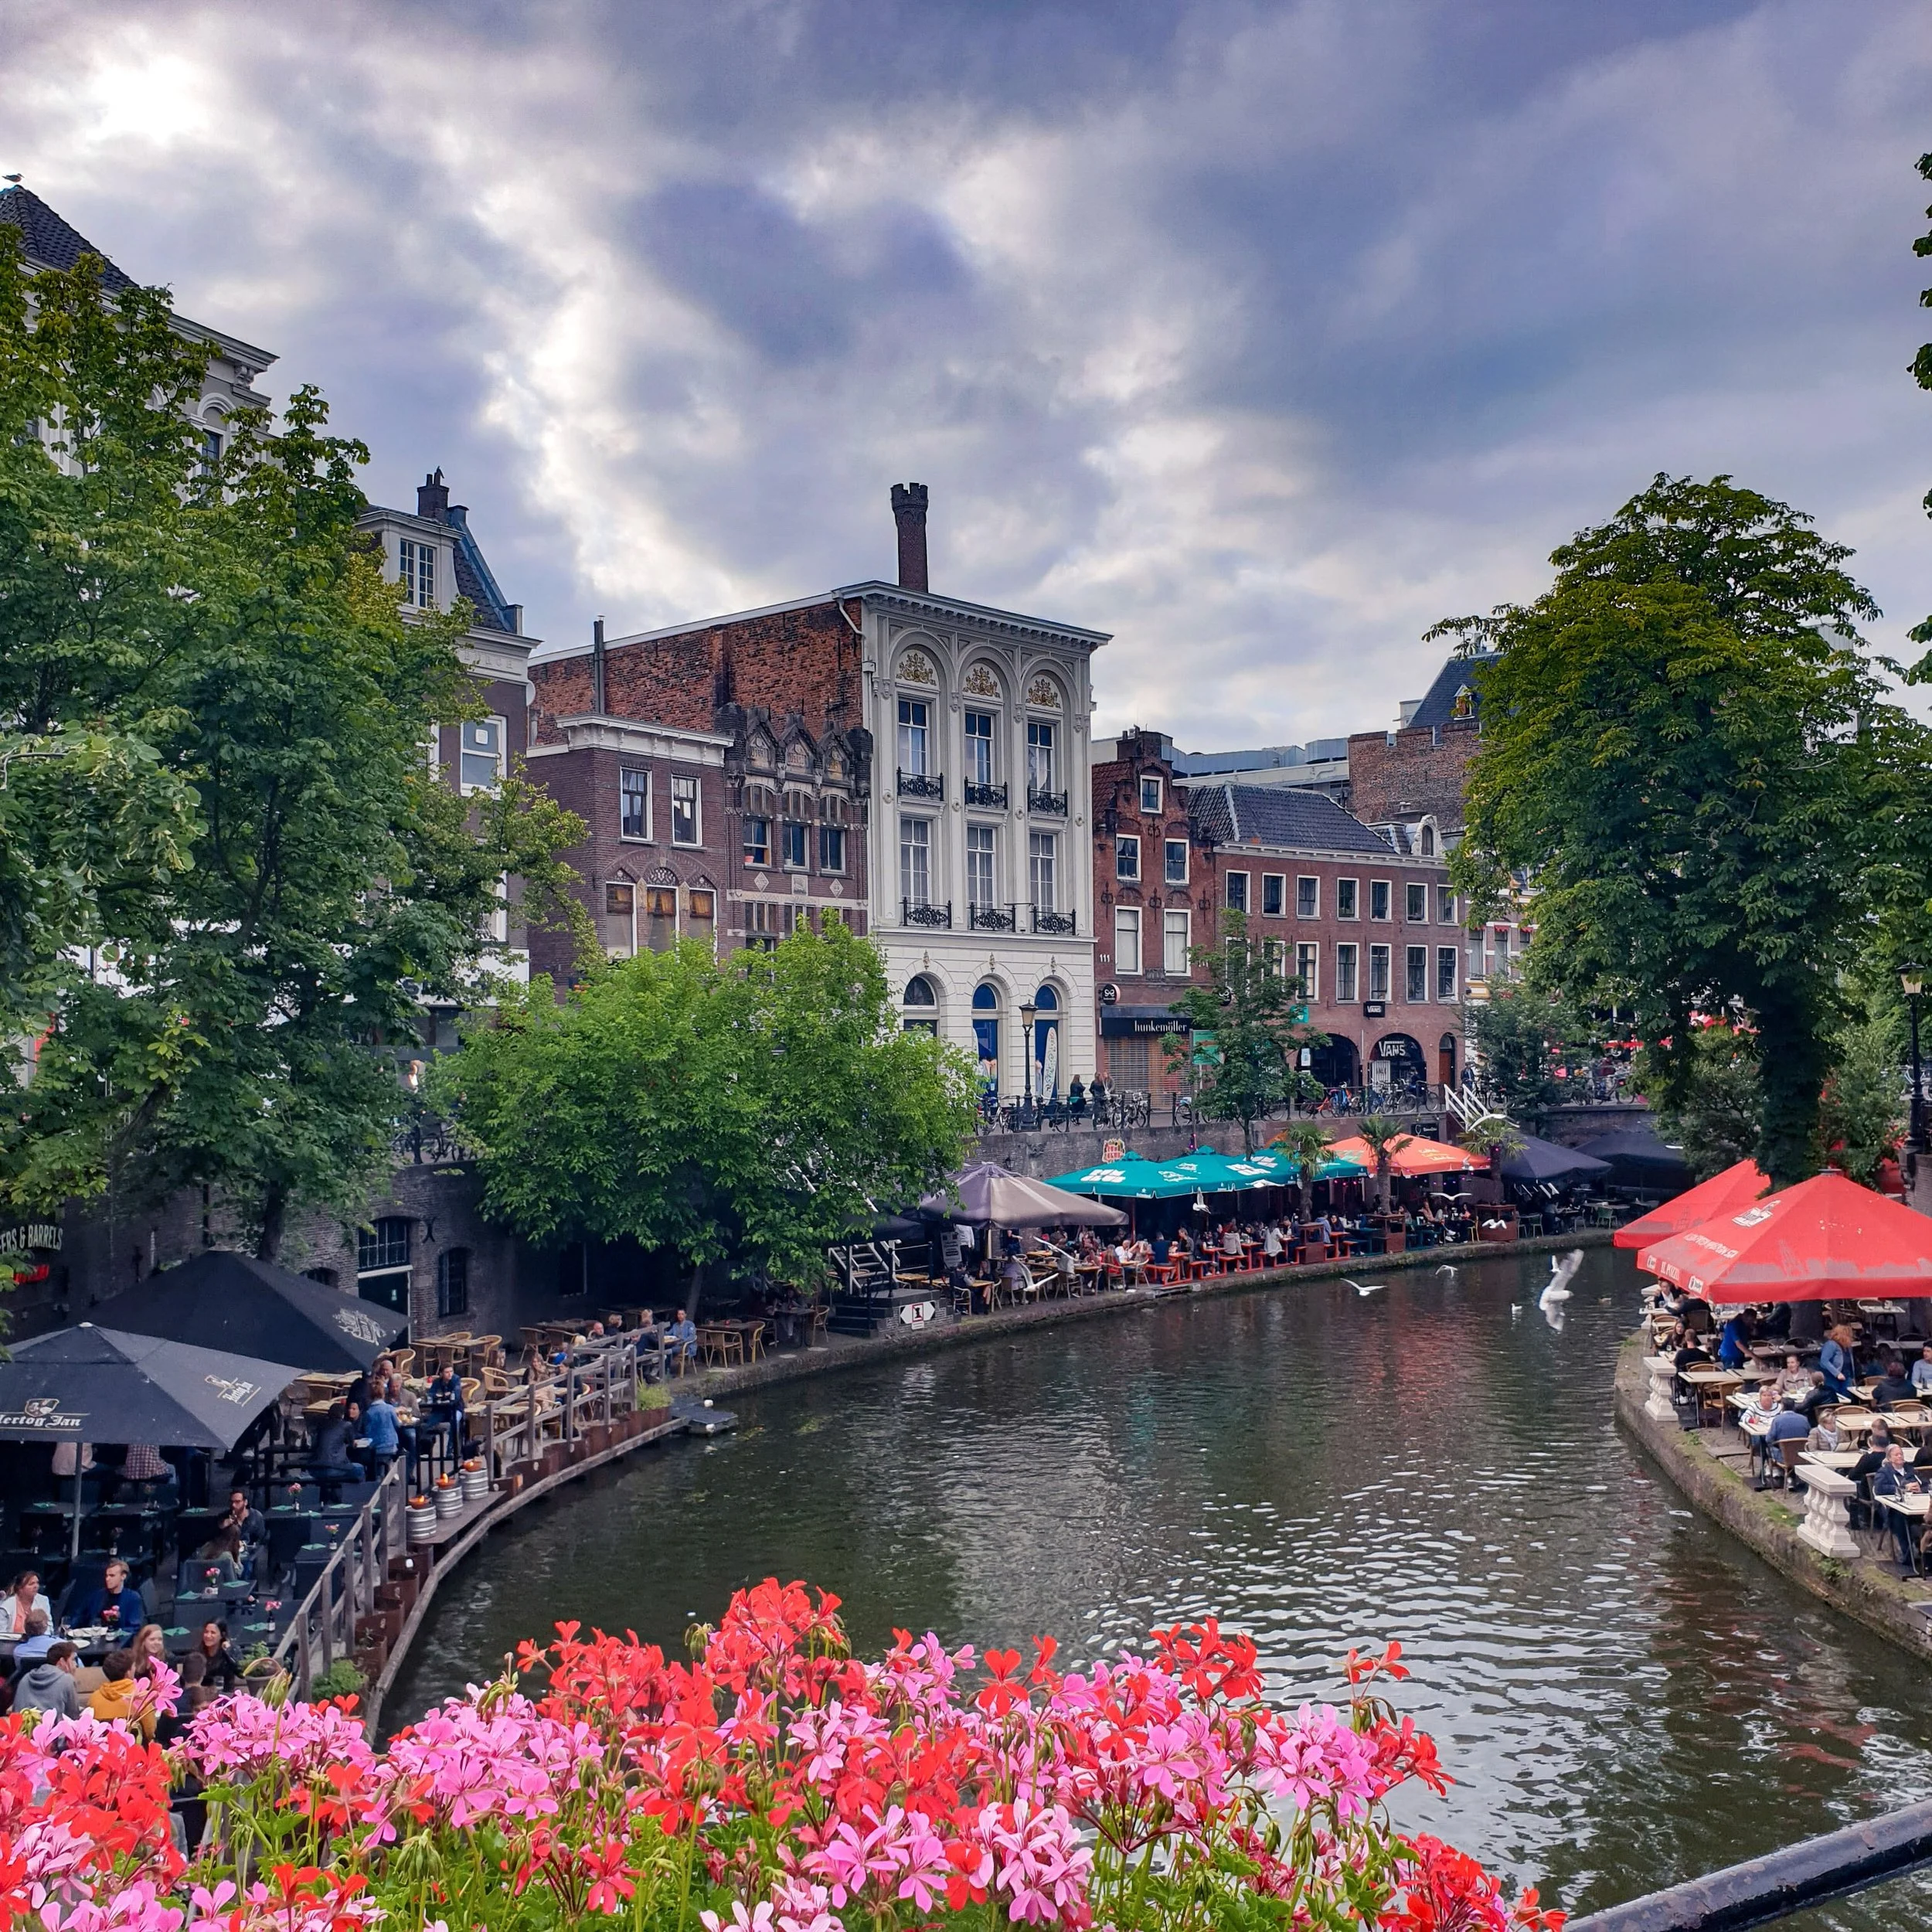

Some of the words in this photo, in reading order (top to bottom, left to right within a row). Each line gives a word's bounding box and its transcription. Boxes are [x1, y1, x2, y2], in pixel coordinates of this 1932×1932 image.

[1134, 1020, 1187, 1032] hunkemöller
[1379, 1041, 1406, 1057] VANS
[0, 1228, 17, 1254] ERS
[19, 1226, 26, 1249] &
[28, 1224, 63, 1250] BARRELS
[45, 1415, 81, 1428] Jan
